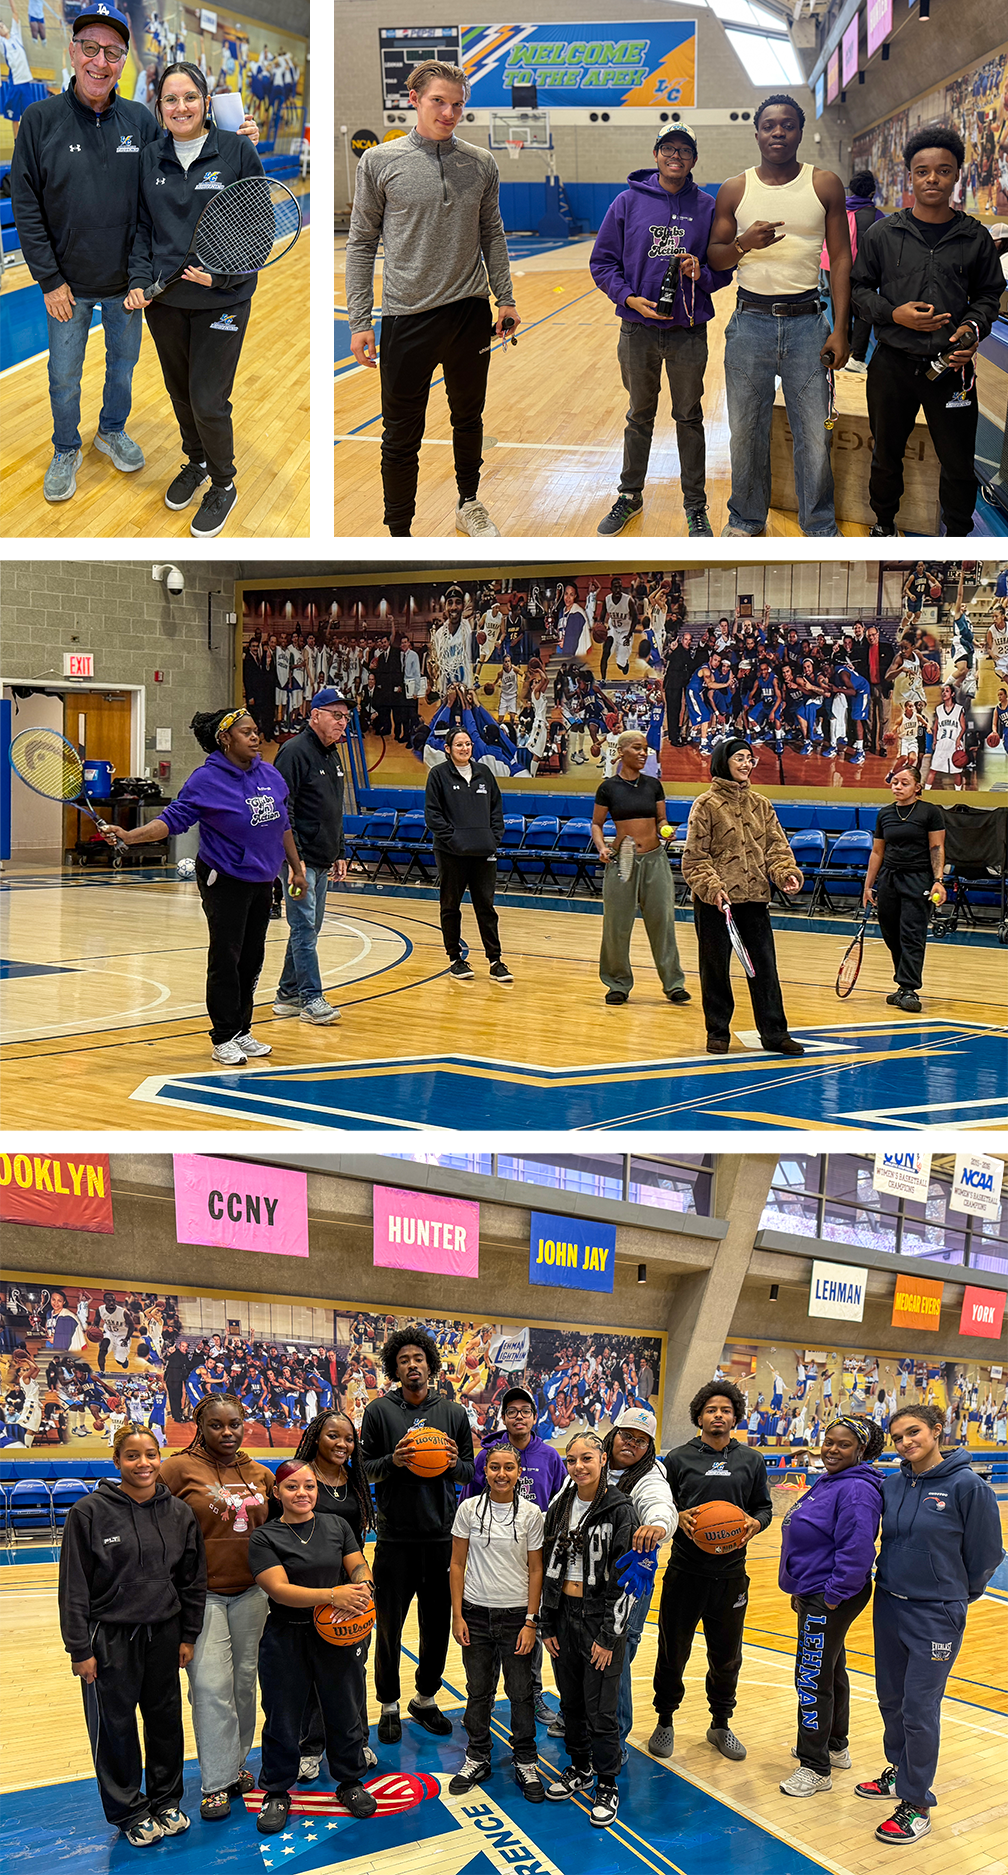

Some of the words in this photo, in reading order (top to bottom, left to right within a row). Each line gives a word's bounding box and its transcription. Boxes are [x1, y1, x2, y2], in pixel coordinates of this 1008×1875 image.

[97, 3, 110, 16] LA
[507, 42, 647, 65] WELCOME
[504, 71, 532, 86] TO
[537, 70, 580, 86] THE
[583, 69, 647, 86] APEX
[351, 140, 378, 150] NCAA
[648, 246, 687, 258] Action
[70, 656, 92, 675] EXIT
[961, 1168, 993, 1192] NCAA
[207, 1190, 279, 1226] CCNY
[388, 1215, 467, 1252] HUNTER
[536, 1239, 578, 1273] JOHN
[583, 1246, 609, 1276] JAY
[815, 1279, 862, 1305] LEHMAN
[895, 1292, 920, 1313] MEDGAR
[921, 1297, 940, 1315] EVERS
[972, 1304, 995, 1323] YORK
[704, 1528, 742, 1541] Wilson
[333, 1617, 374, 1637] Wilson
[797, 1613, 827, 1730] LEHMAN
